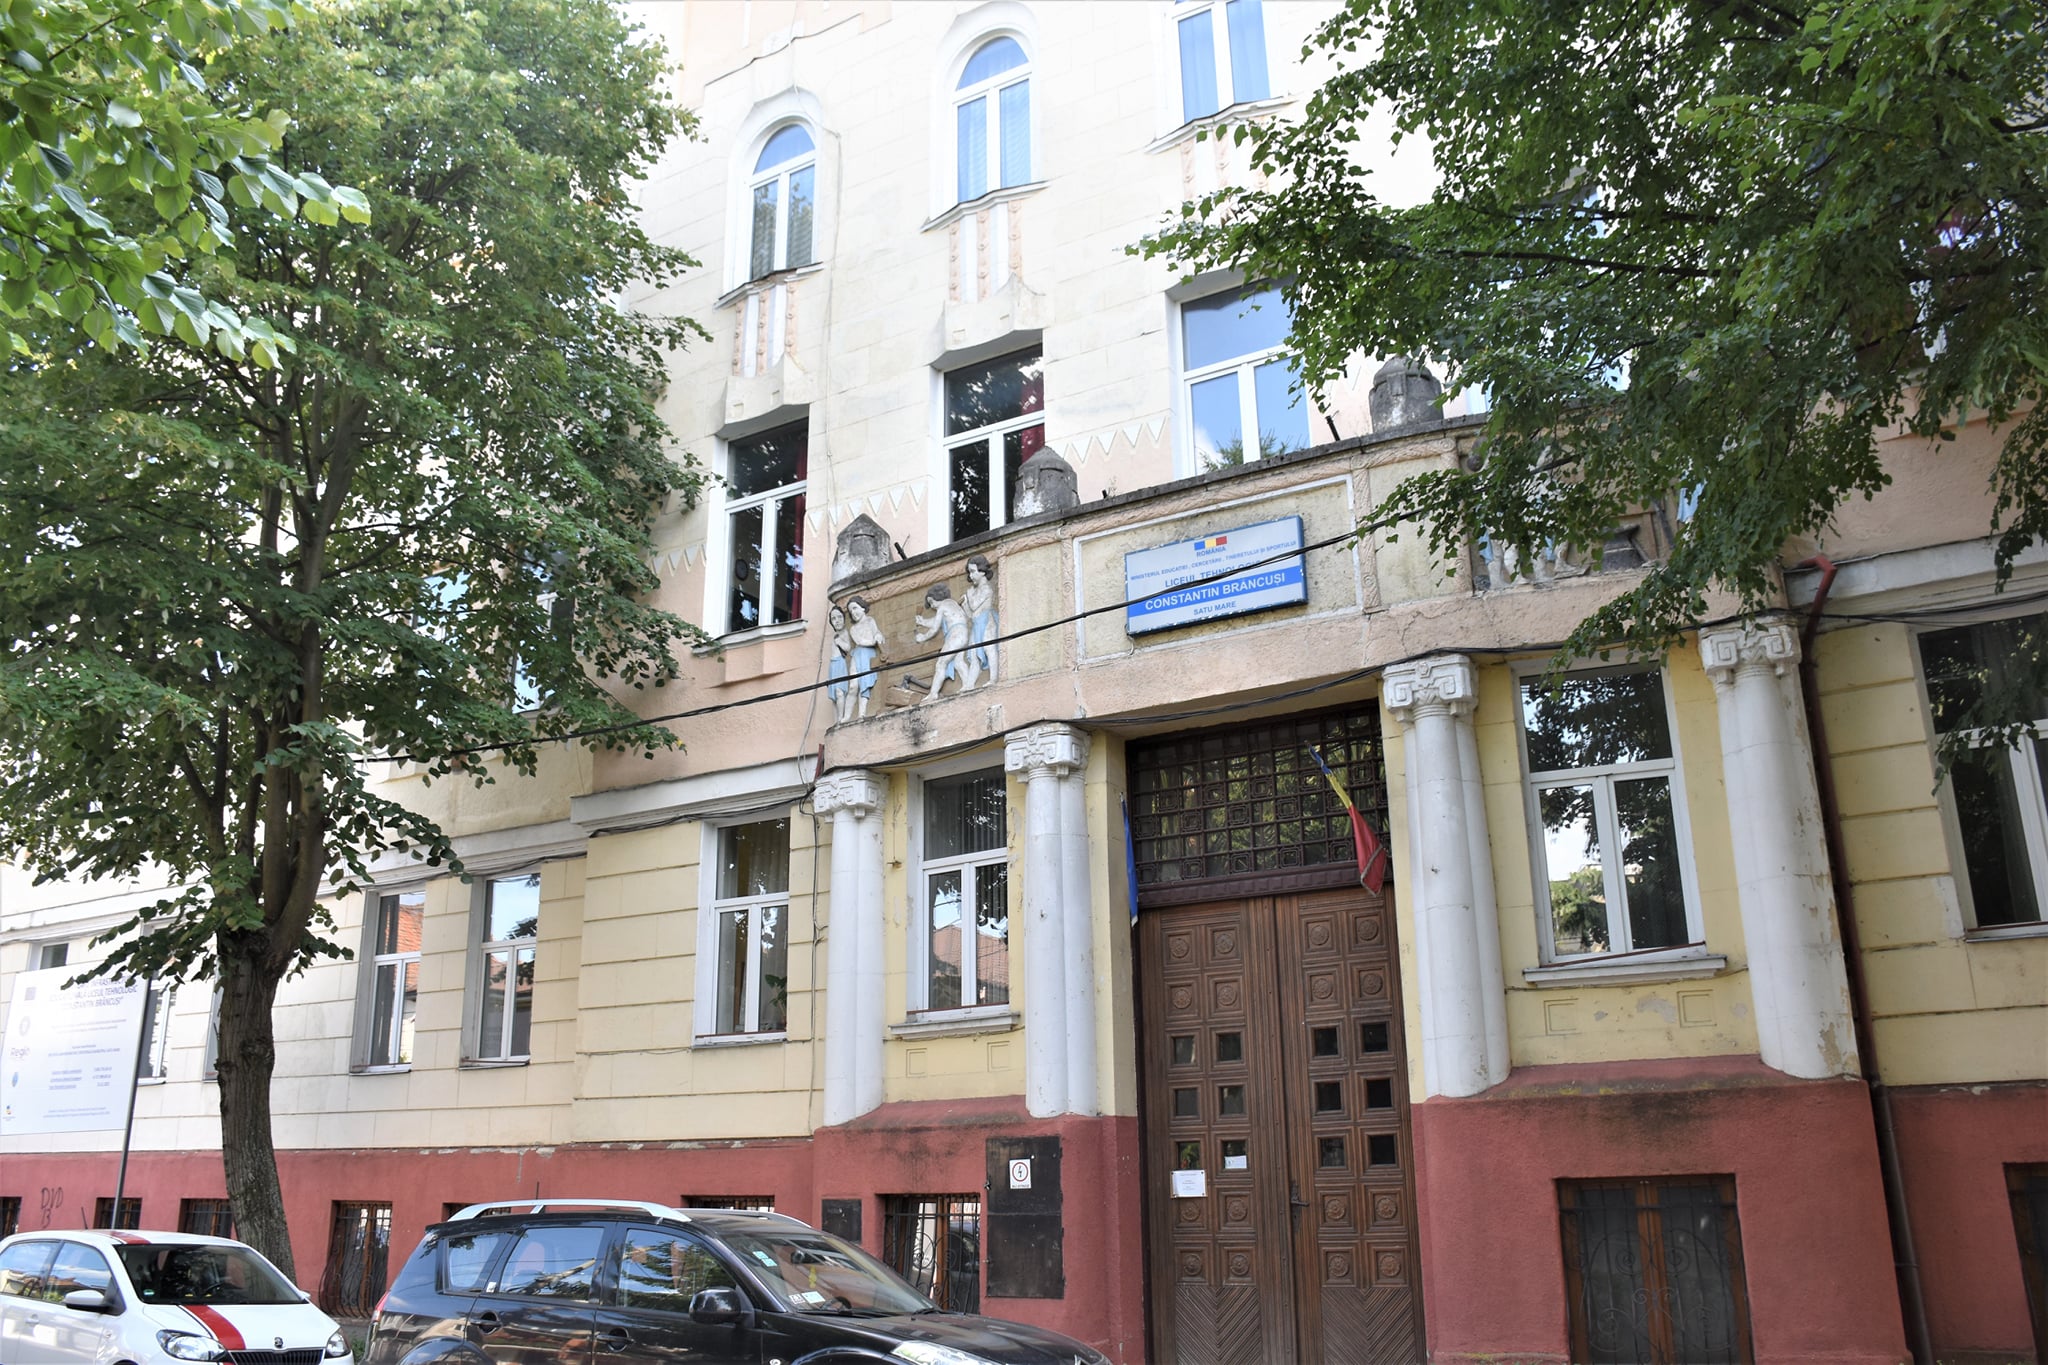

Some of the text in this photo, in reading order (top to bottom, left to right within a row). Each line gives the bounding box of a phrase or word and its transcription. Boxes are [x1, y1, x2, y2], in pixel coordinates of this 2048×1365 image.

[1145, 586, 1220, 610] CONSTANTIN
[1193, 601, 1237, 616] SATU MARE
